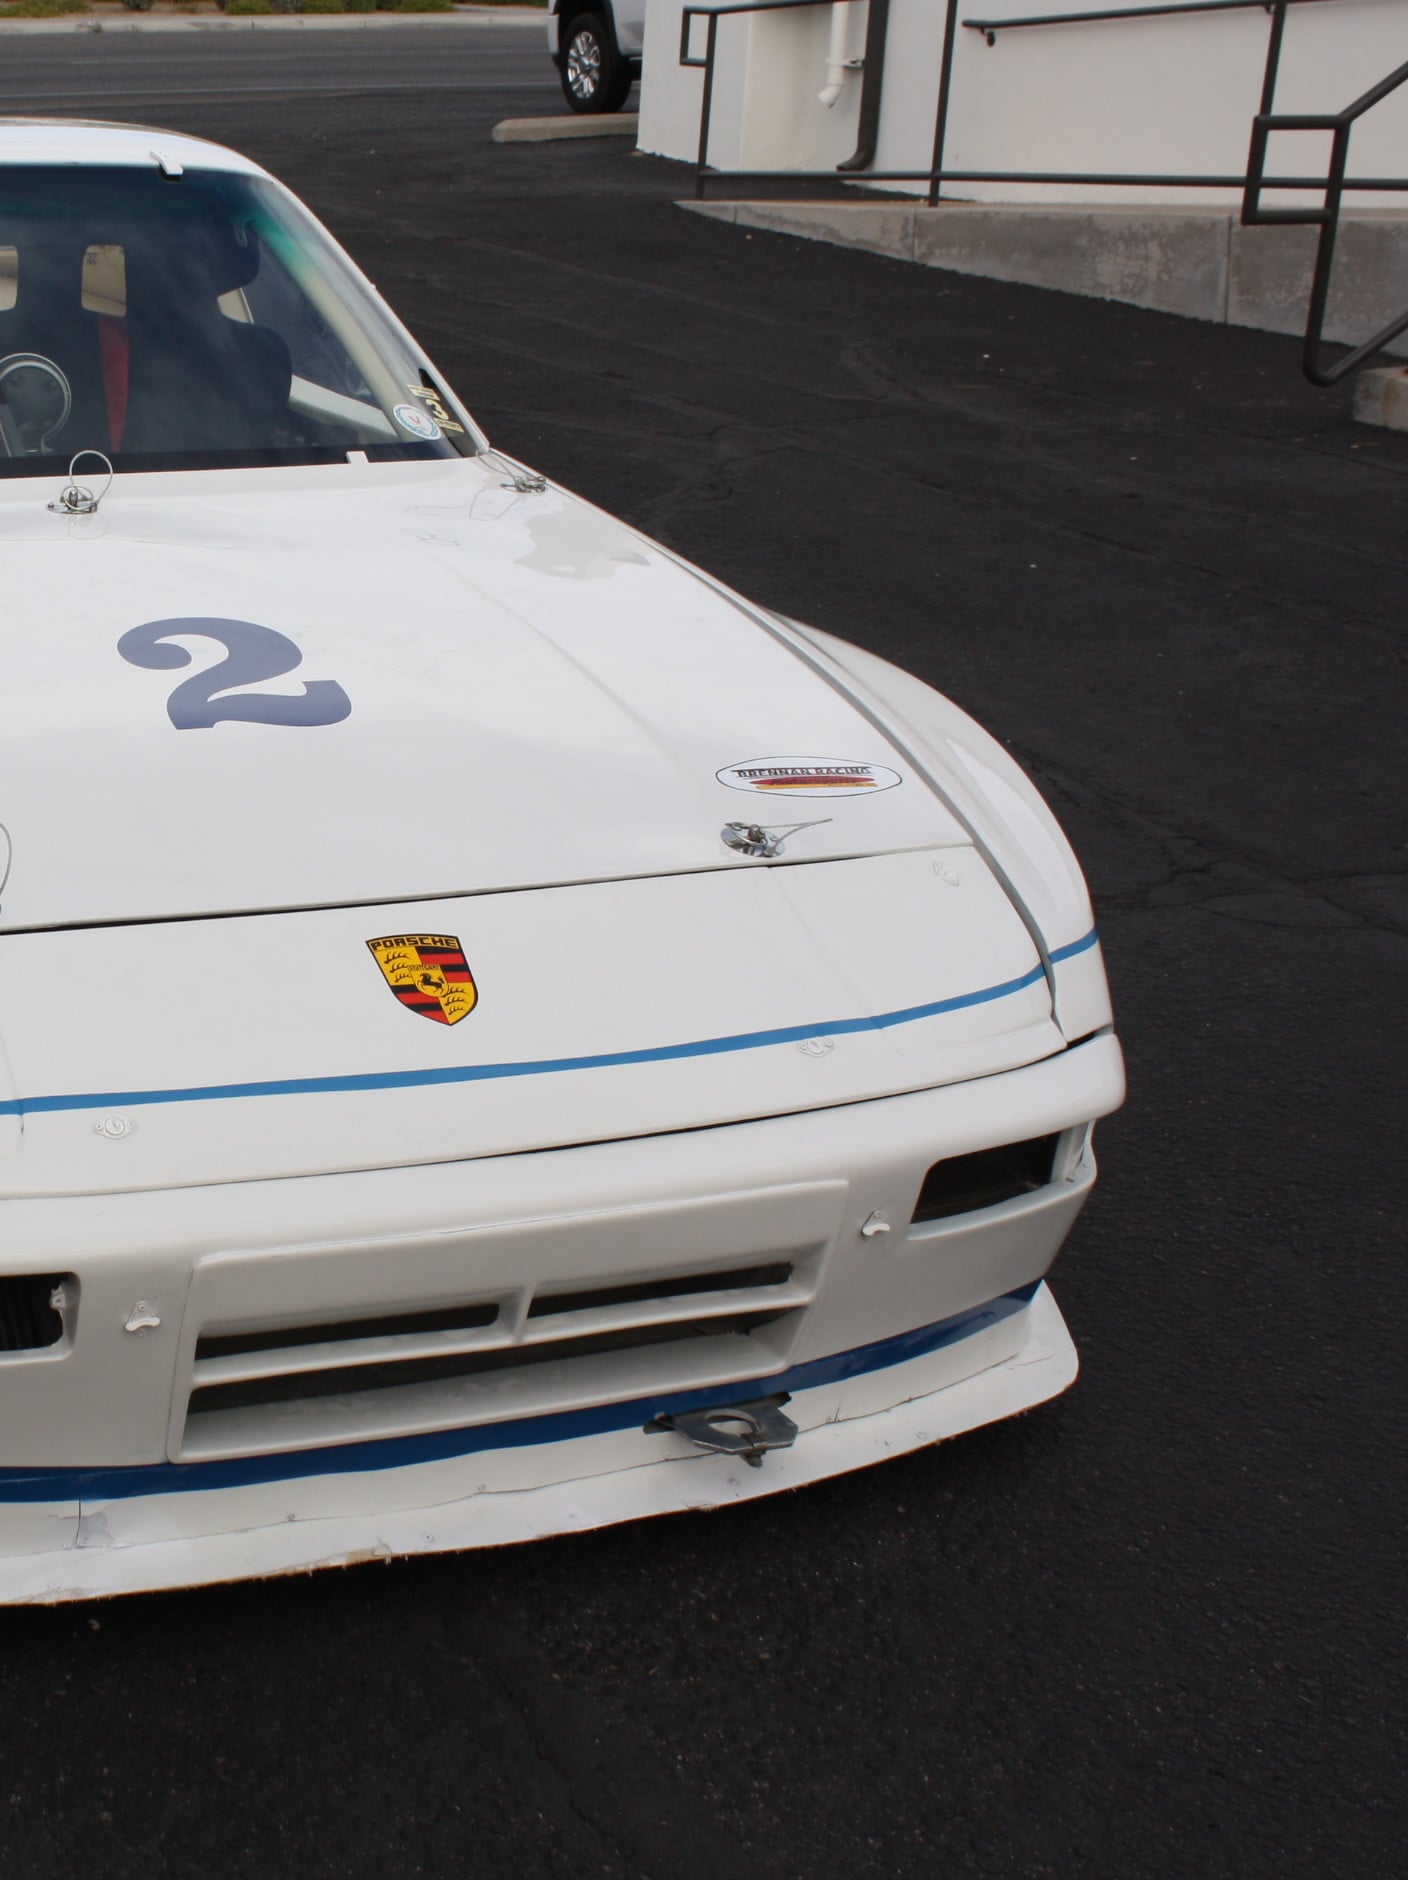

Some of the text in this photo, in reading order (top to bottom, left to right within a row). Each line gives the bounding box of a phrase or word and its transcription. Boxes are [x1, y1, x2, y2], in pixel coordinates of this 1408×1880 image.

[117, 617, 352, 730] 2
[735, 766, 872, 778] BRENNAN RACING
[370, 936, 458, 951] PORSCHE
